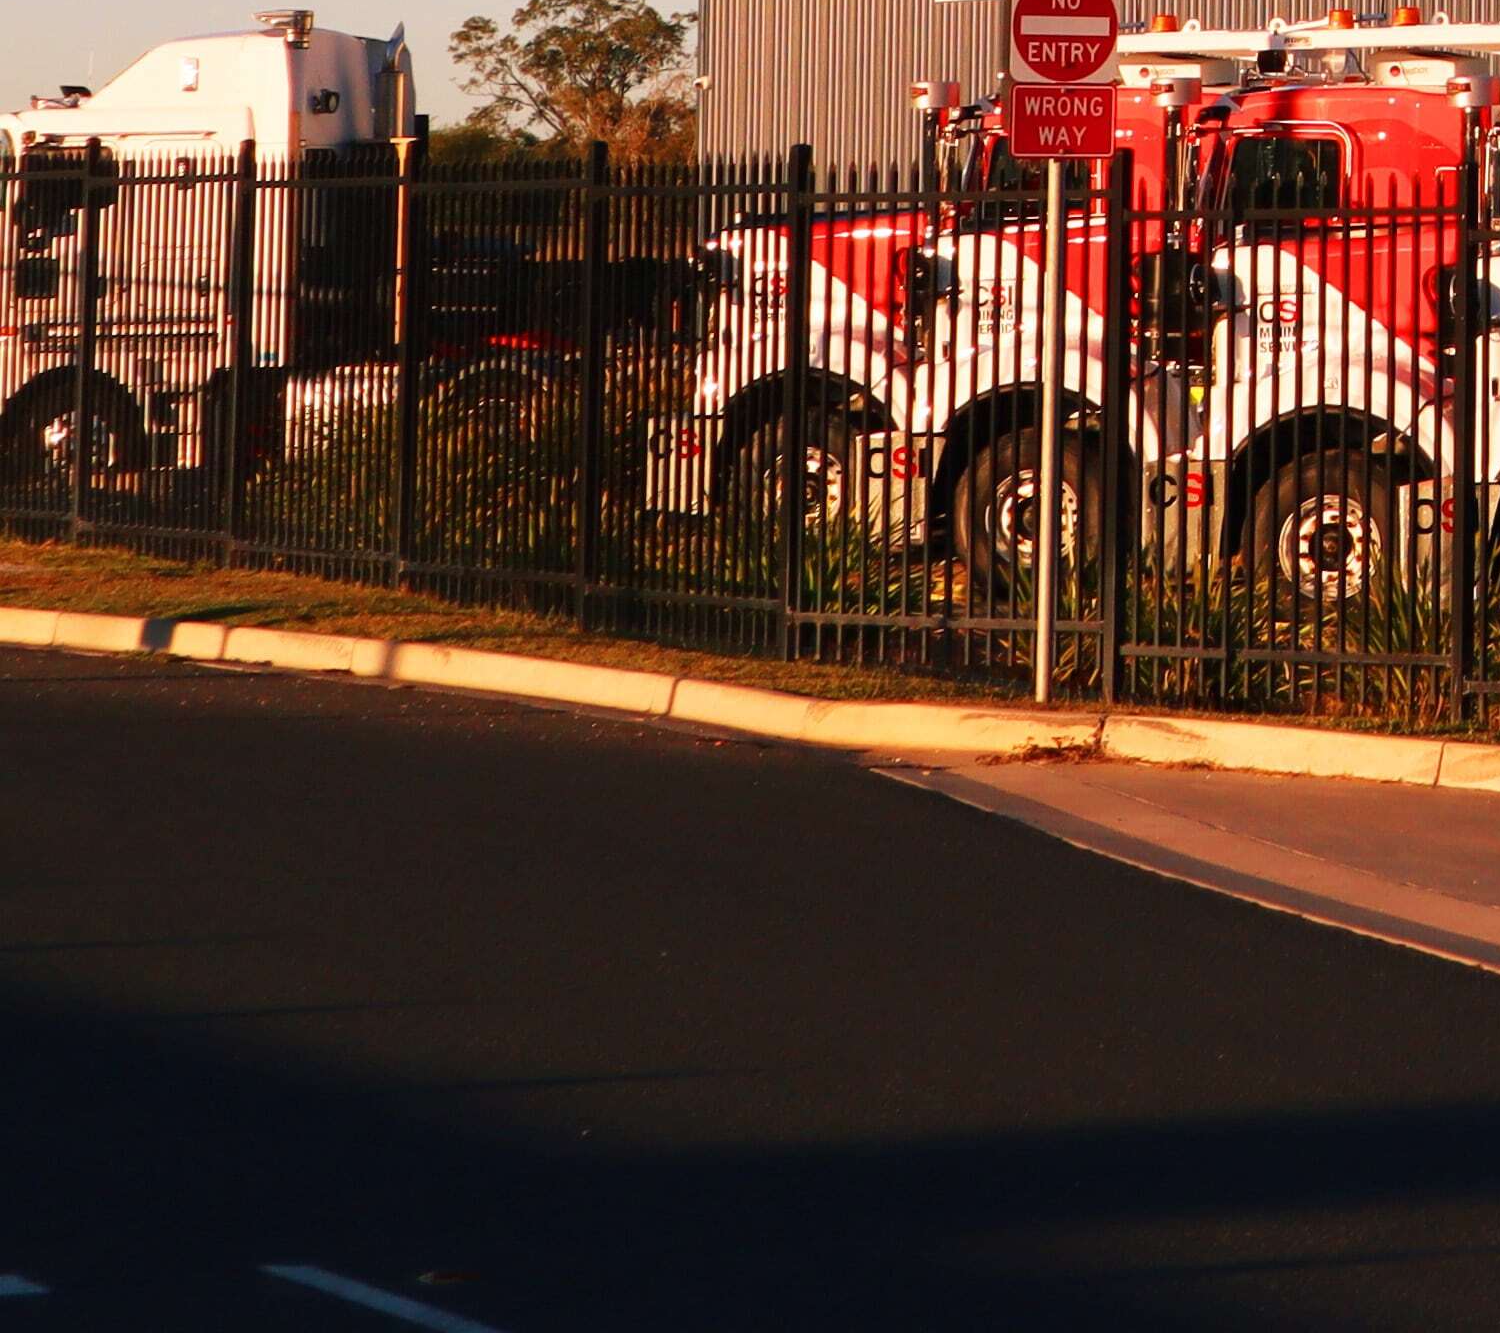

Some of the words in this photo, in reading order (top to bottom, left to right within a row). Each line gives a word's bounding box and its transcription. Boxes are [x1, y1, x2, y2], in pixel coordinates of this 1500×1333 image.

[1028, 41, 1100, 64] ENTRY
[1025, 96, 1104, 117] WRONG
[1038, 125, 1087, 146] WAY
